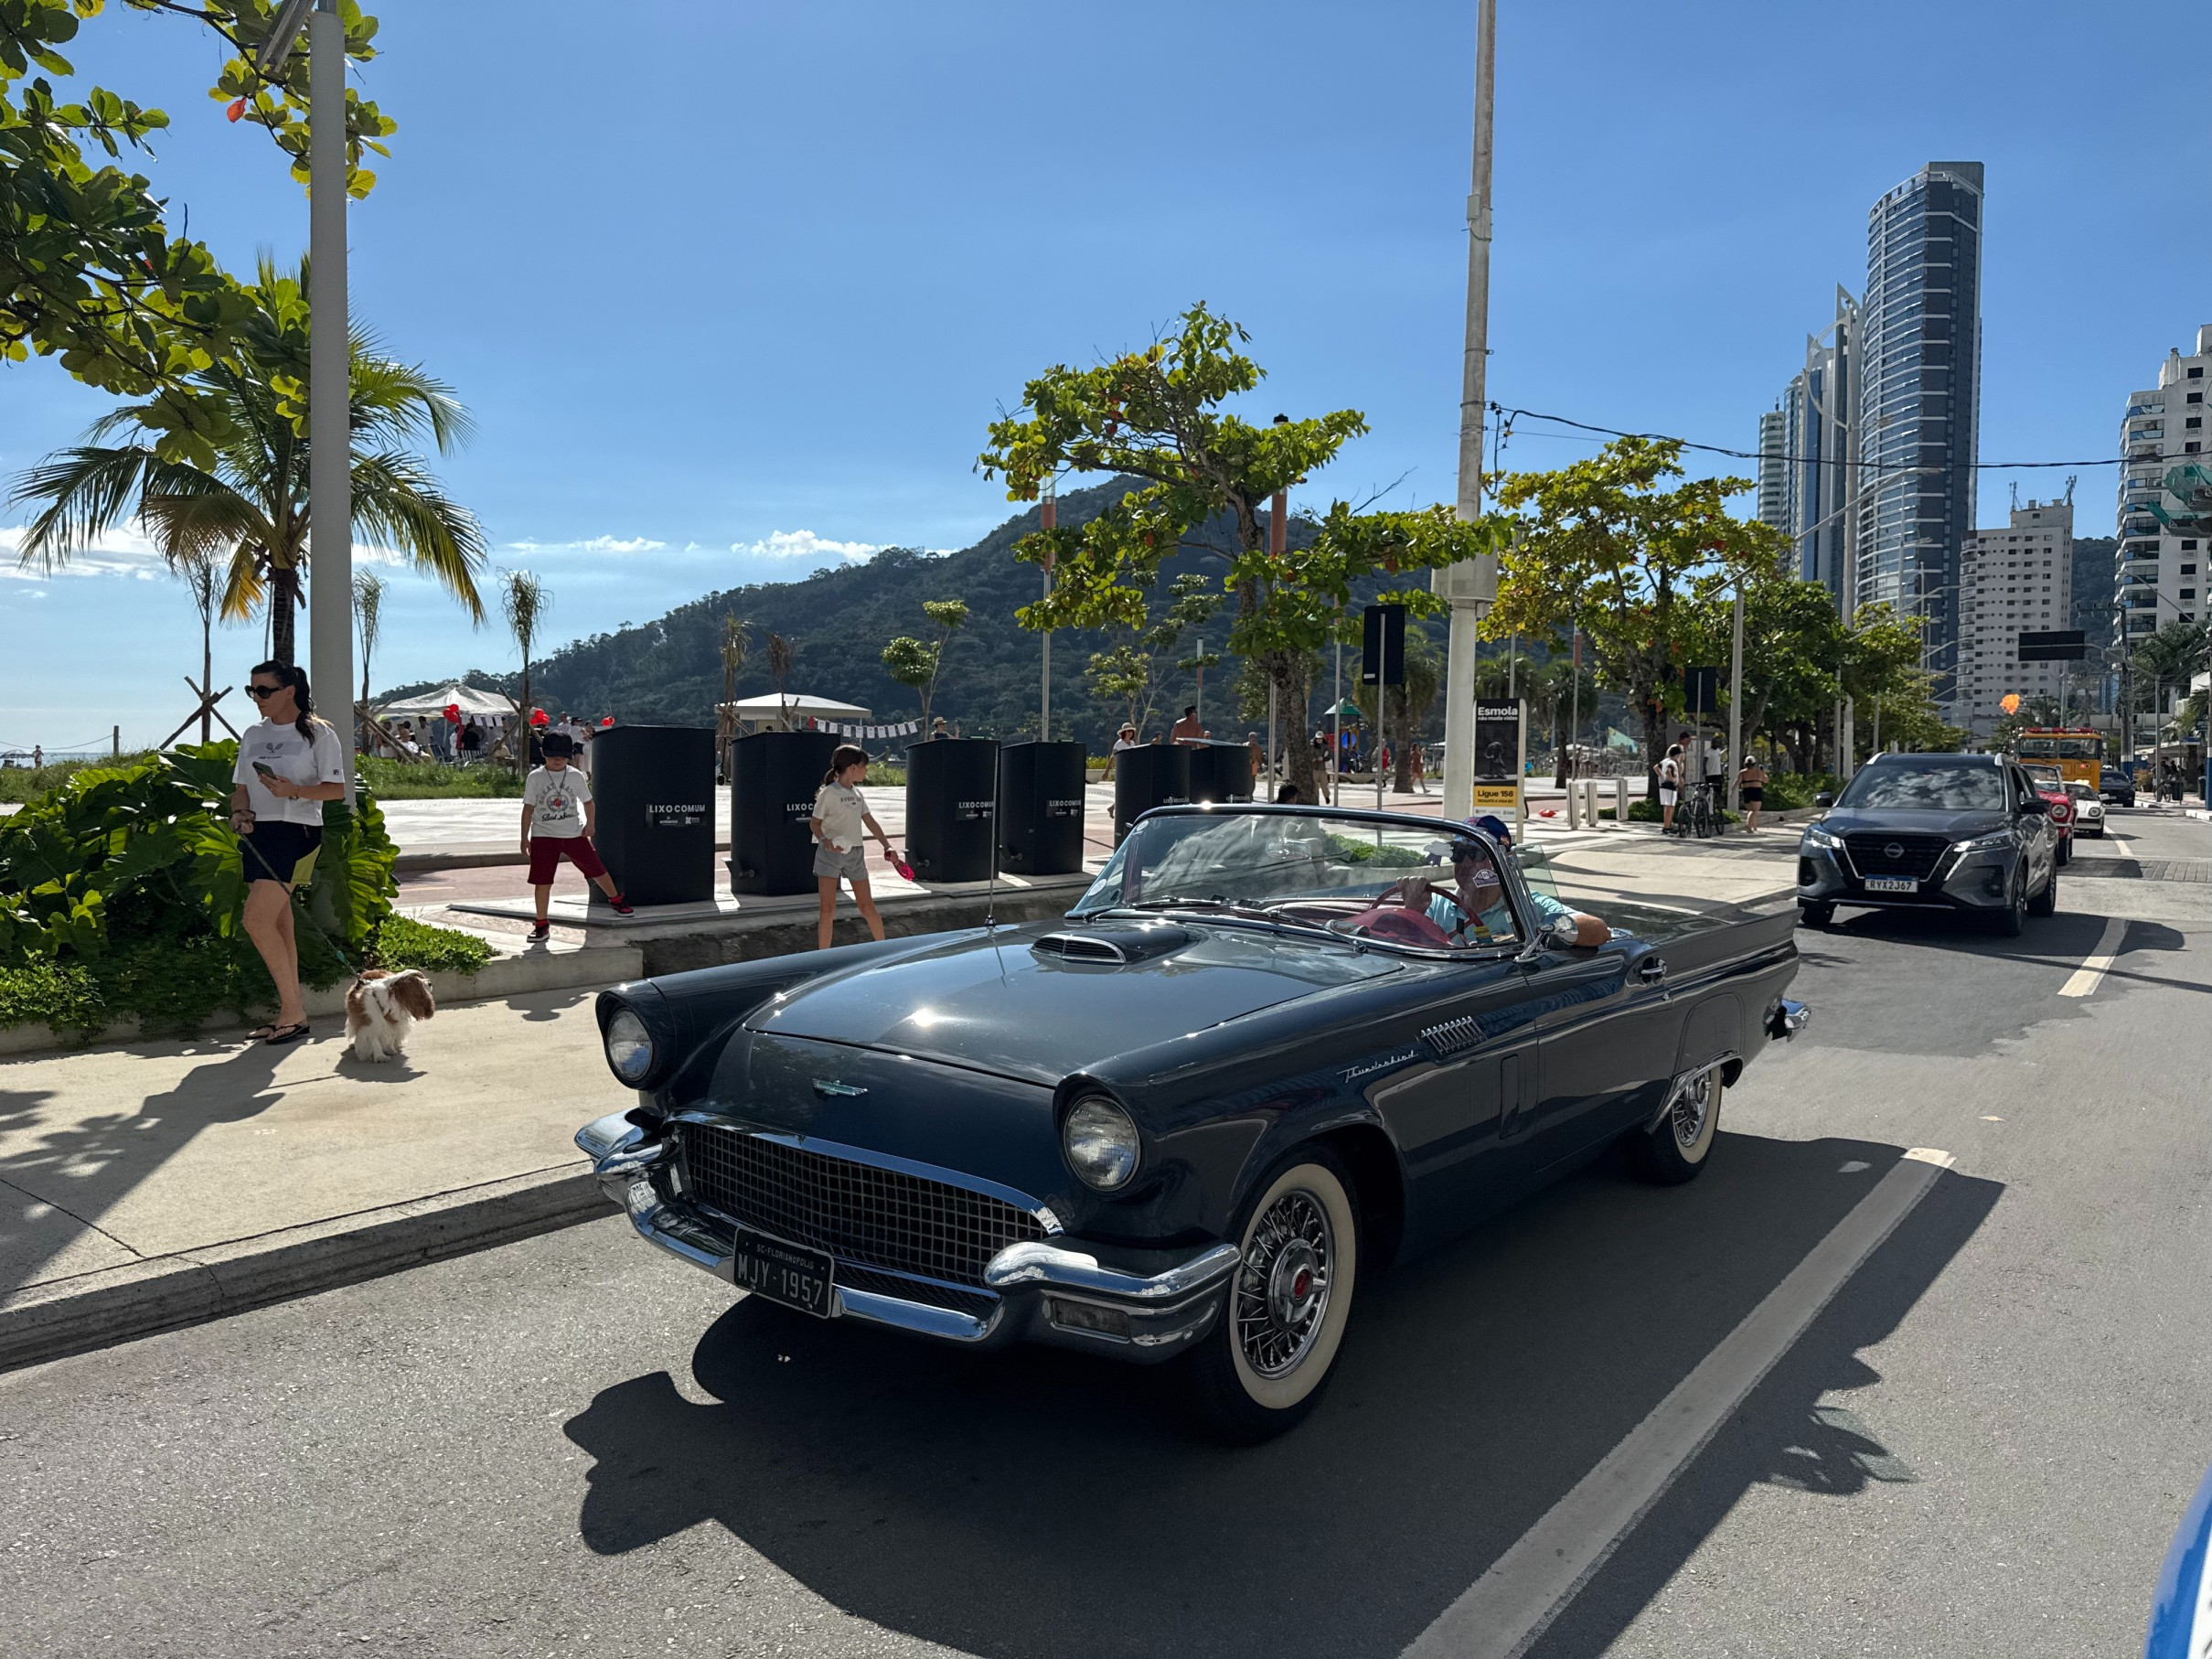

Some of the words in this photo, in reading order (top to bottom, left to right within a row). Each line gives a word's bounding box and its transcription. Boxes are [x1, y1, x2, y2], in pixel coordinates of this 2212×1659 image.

[1478, 706, 1518, 715] Esmola
[649, 805, 673, 813] LIXO
[786, 803, 807, 811] LIXO
[1870, 880, 1912, 891] RYX2J67
[1336, 1049, 1418, 1083] Thunderbird
